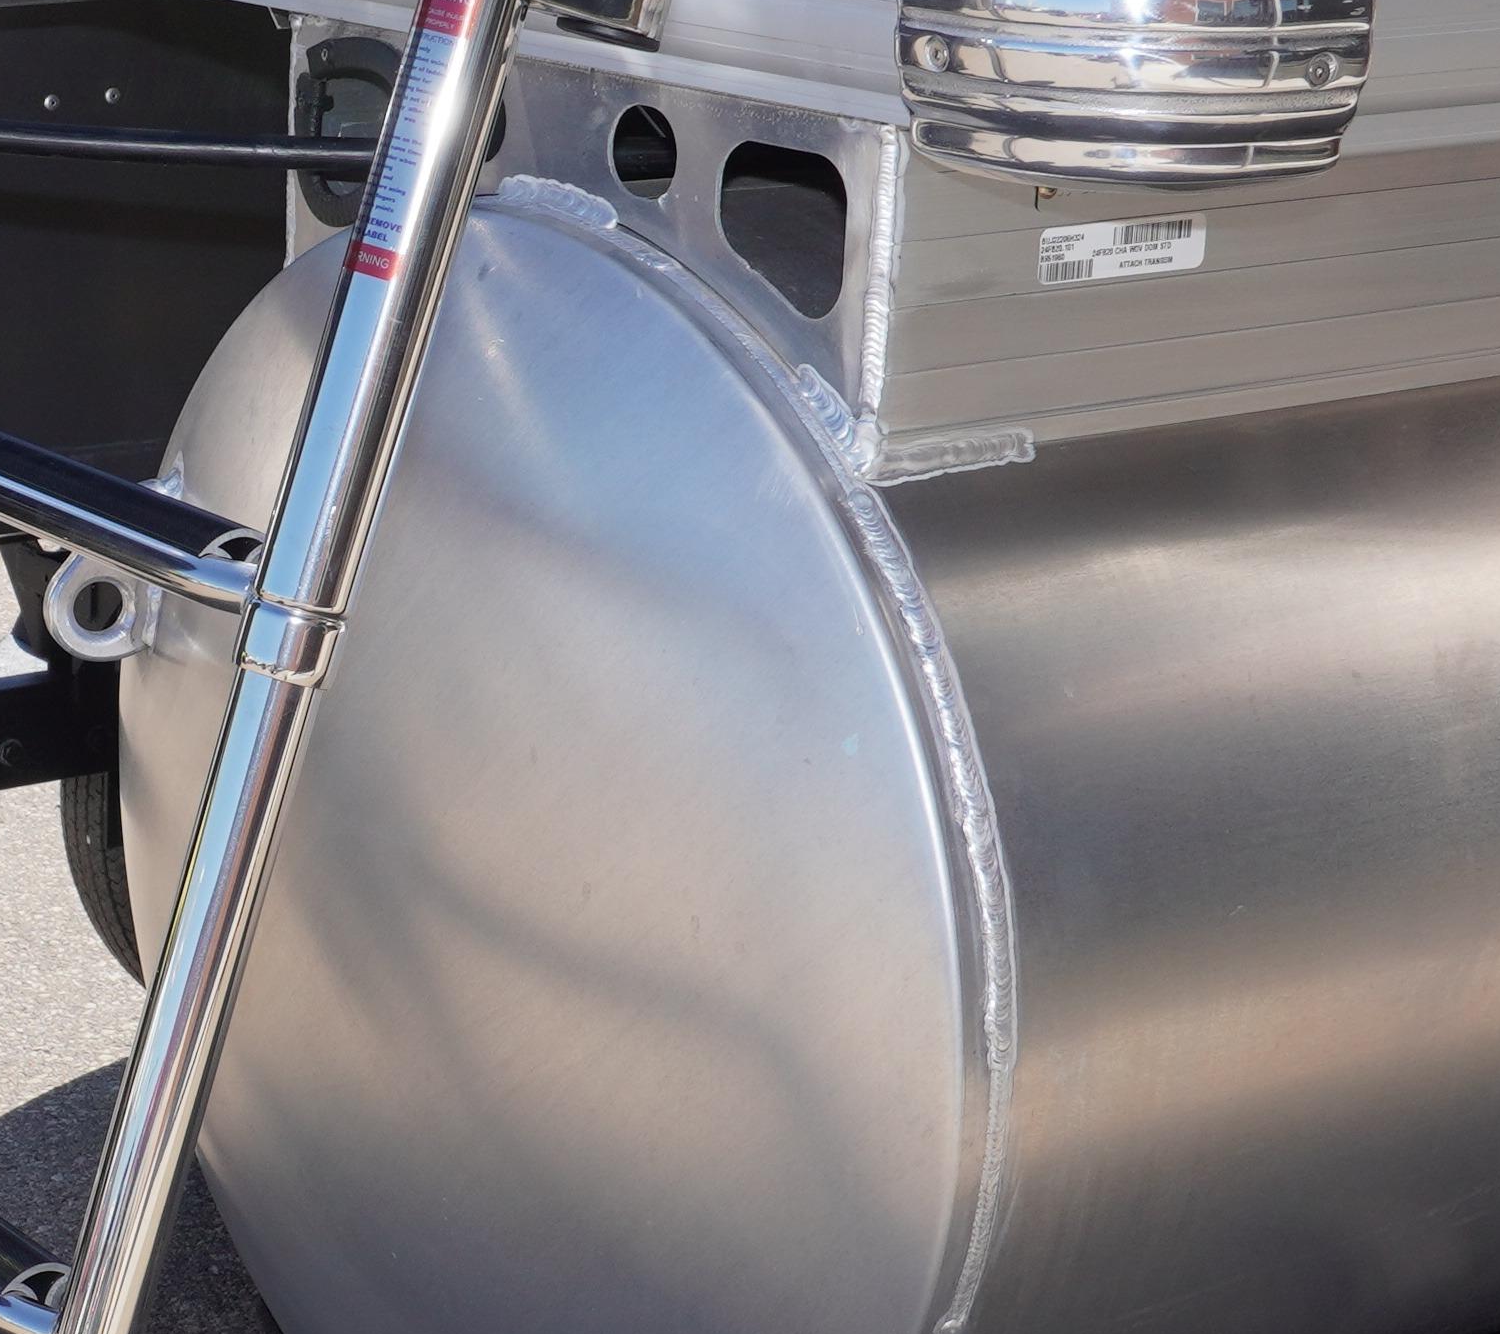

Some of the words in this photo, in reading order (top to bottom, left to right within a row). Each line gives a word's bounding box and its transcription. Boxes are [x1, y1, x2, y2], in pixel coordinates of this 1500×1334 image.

[358, 252, 390, 268] RNING
[1119, 259, 1143, 269] ATTACH
[1145, 256, 1173, 266] TRANSOM
